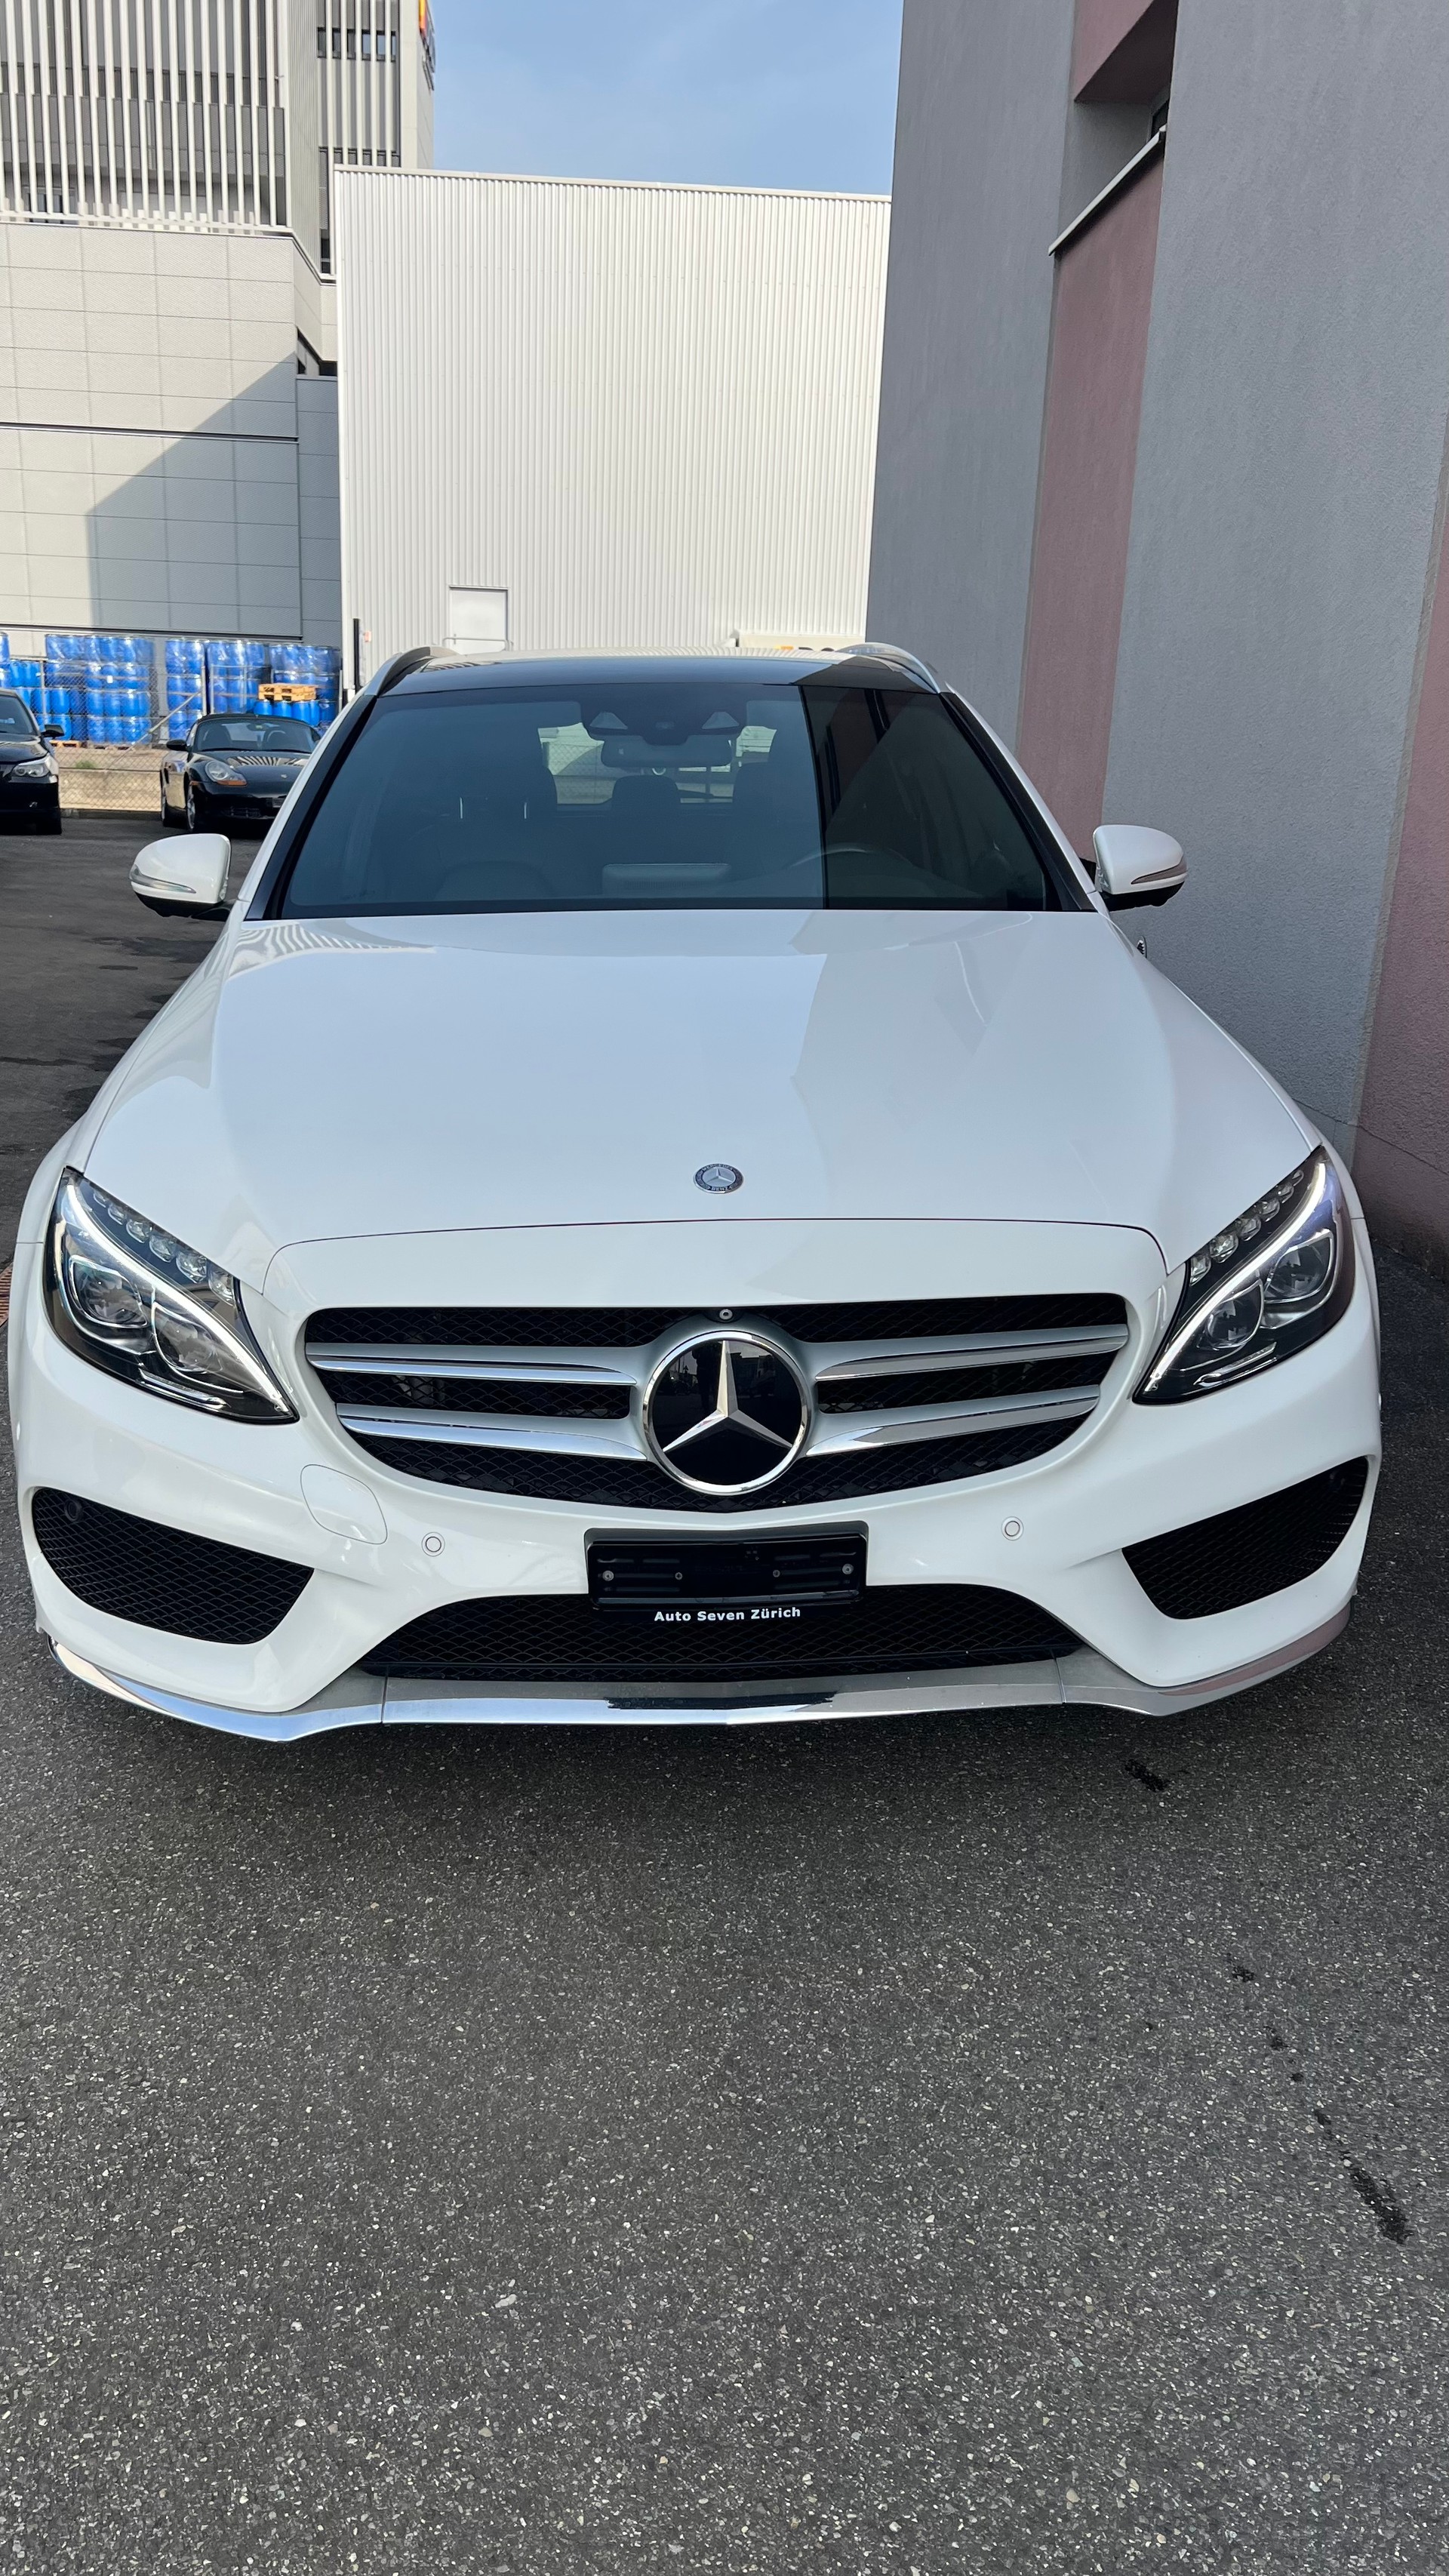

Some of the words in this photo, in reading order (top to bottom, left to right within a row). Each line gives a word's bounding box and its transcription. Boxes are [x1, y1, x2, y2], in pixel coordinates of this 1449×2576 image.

[654, 1611, 691, 1621] Auto
[697, 1611, 745, 1621] Seven
[750, 1607, 801, 1620] Zürich
